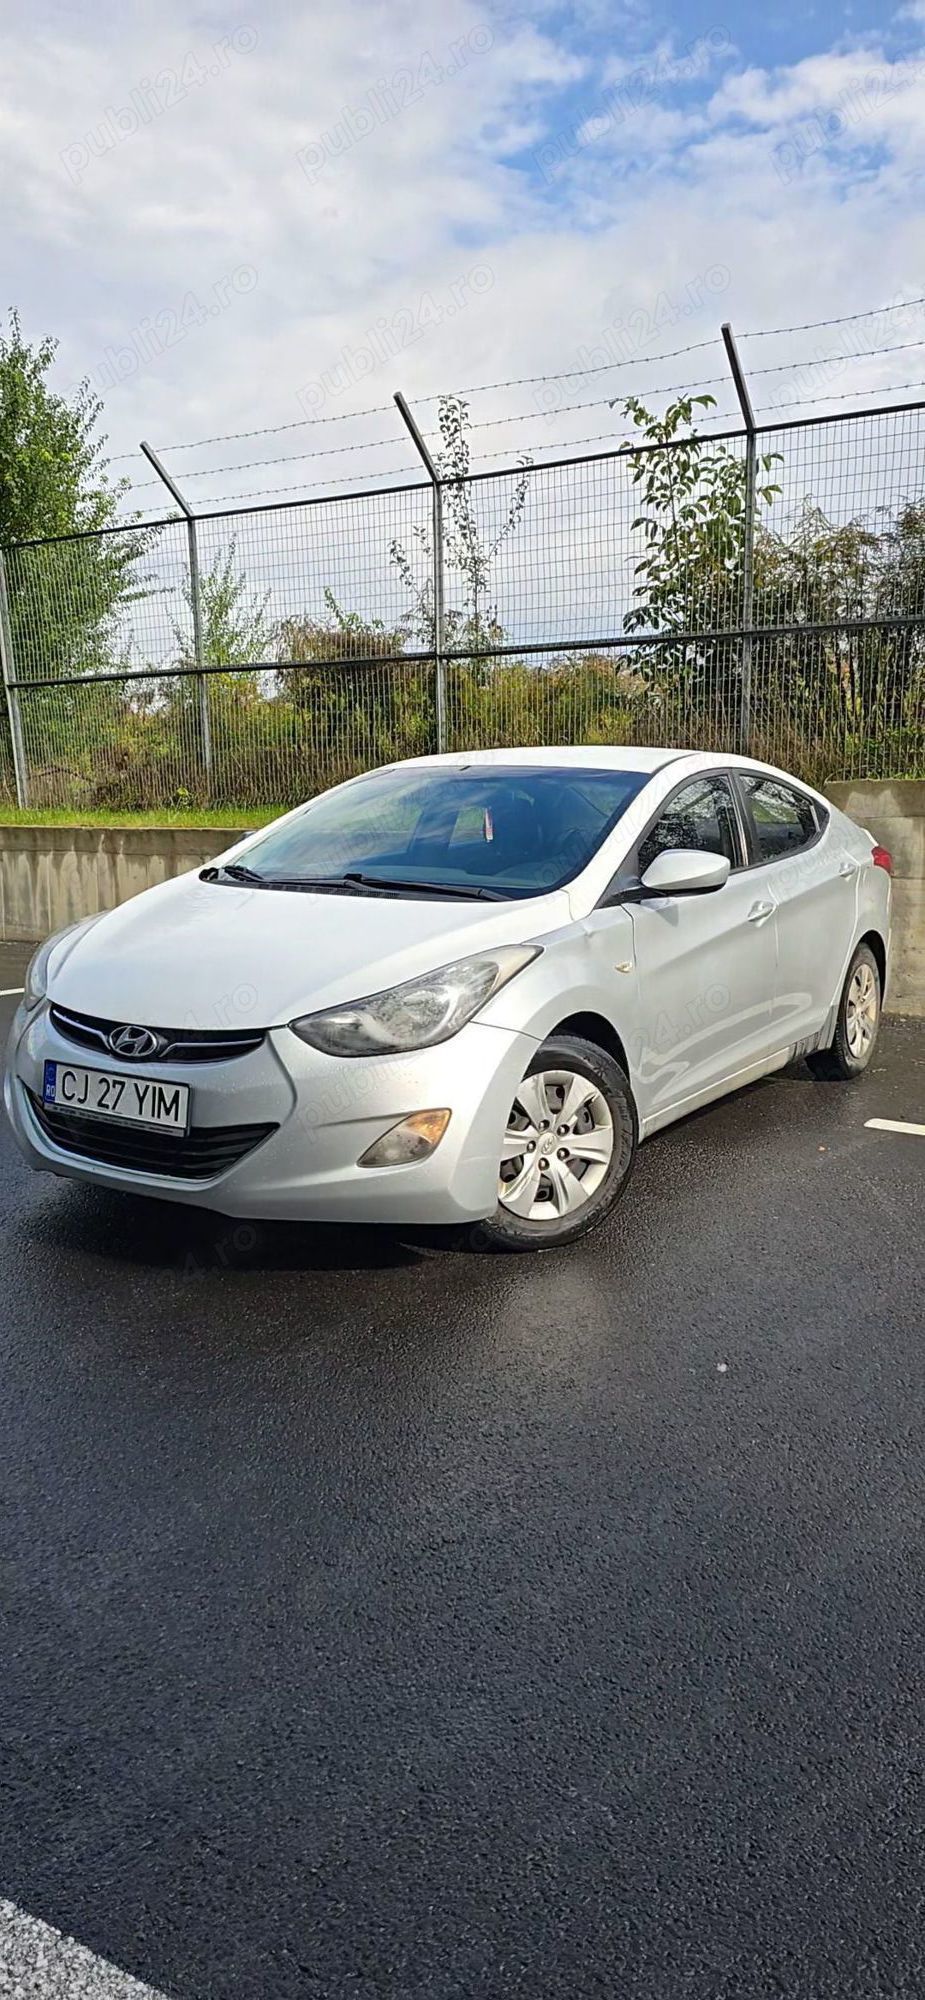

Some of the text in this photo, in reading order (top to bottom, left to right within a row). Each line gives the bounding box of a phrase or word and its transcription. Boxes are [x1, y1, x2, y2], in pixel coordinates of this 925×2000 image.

[61, 1070, 89, 1104] CJ
[97, 1077, 126, 1110] 27
[133, 1082, 180, 1122] YIM
